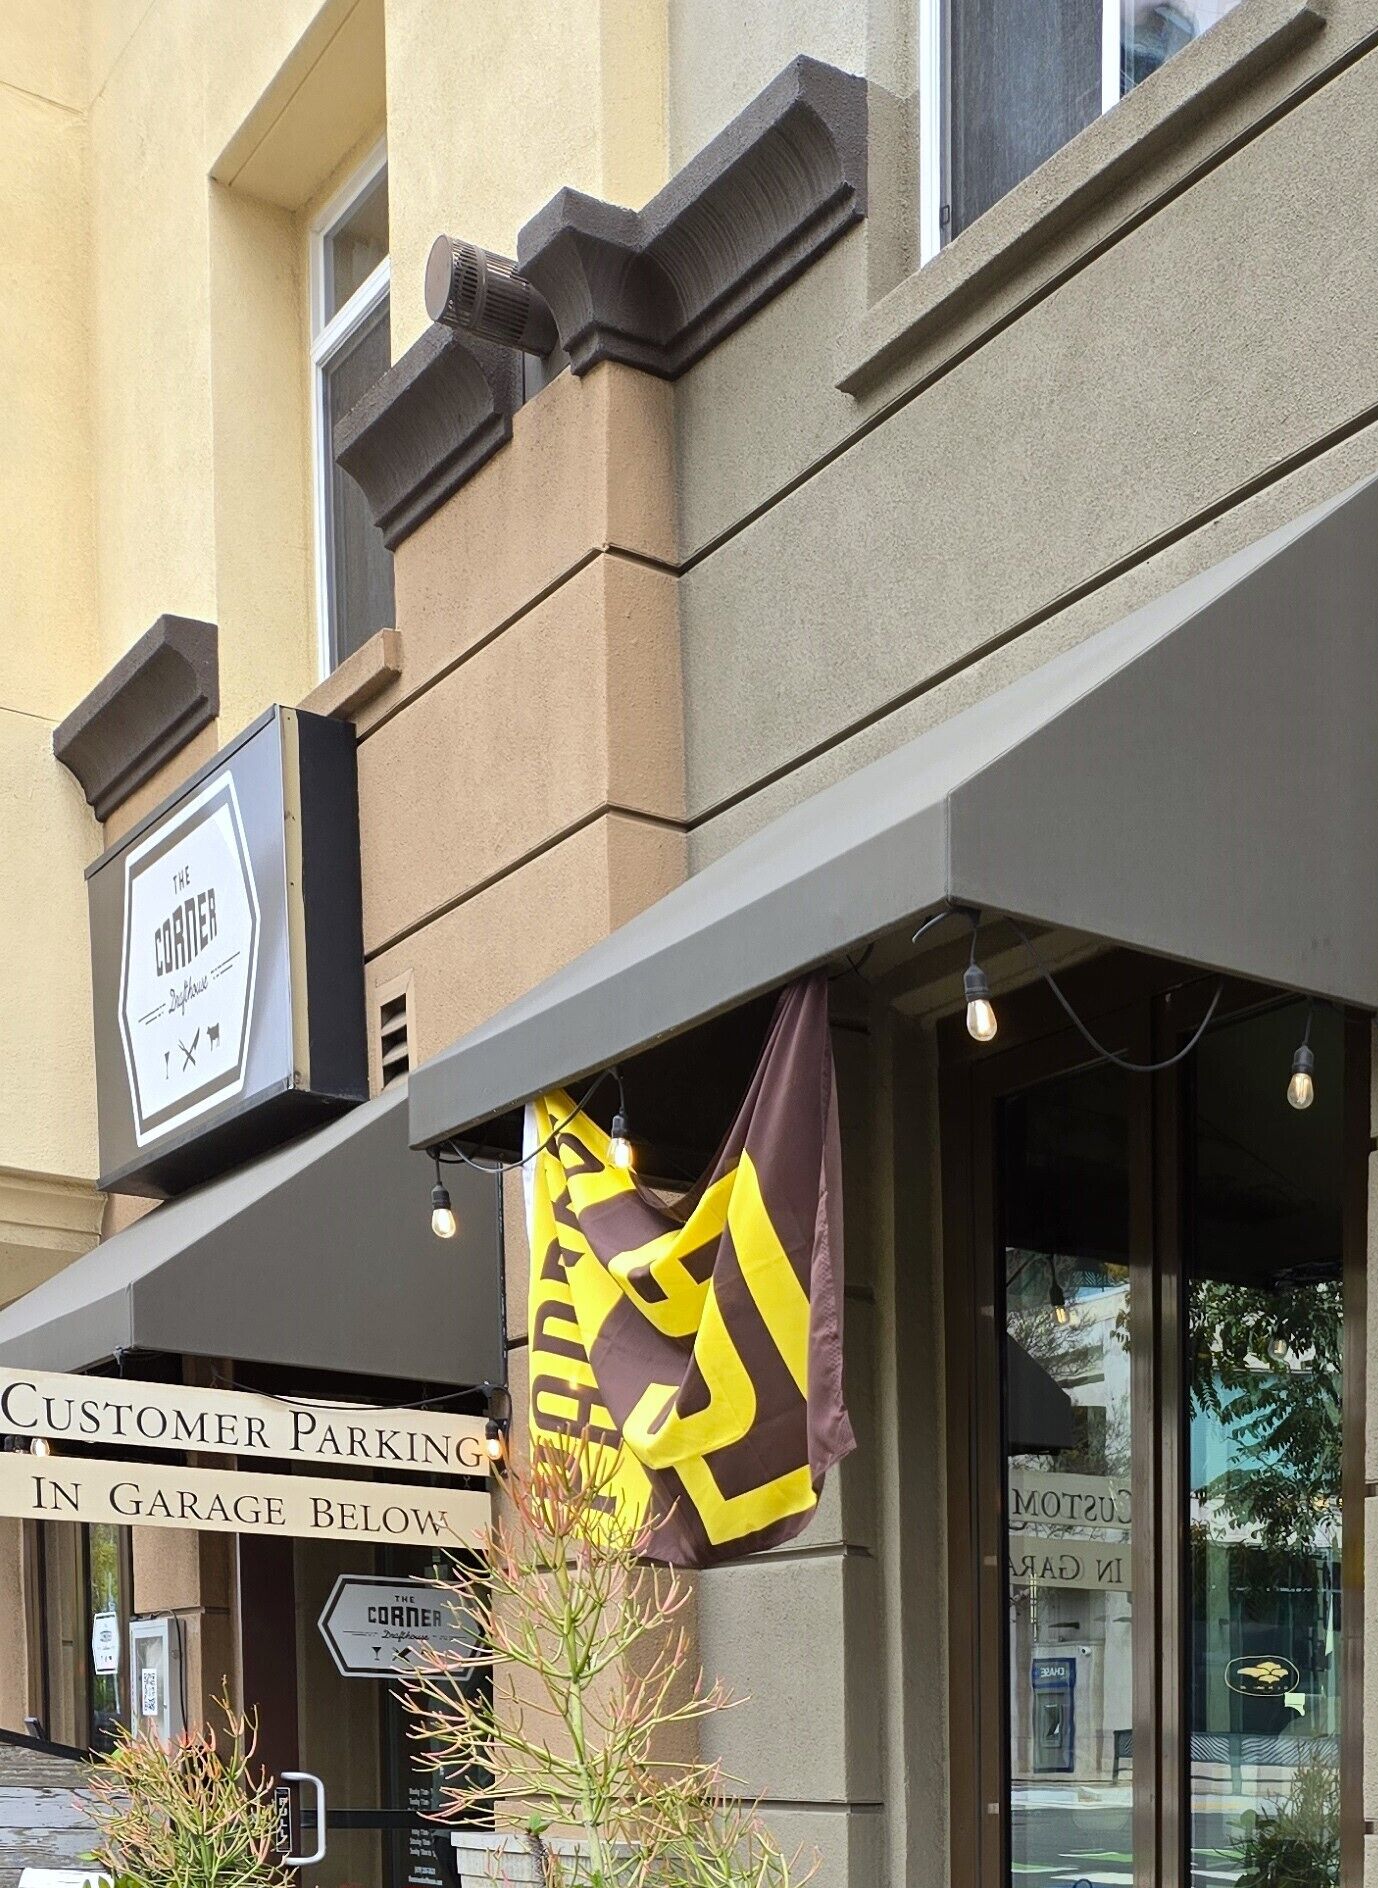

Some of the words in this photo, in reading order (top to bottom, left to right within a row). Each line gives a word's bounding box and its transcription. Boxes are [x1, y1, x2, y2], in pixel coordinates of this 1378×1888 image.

[172, 865, 191, 895] THE
[154, 887, 218, 977] CORNER
[1, 1382, 271, 1448] CUSTOMER
[288, 1409, 483, 1468] PARKING
[30, 1475, 82, 1512] IN
[109, 1482, 286, 1526] GARAGE
[308, 1496, 448, 1537] BELOW
[394, 1595, 415, 1604] THE
[367, 1606, 442, 1628] CORNER
[381, 1629, 430, 1642] Drafthouse
